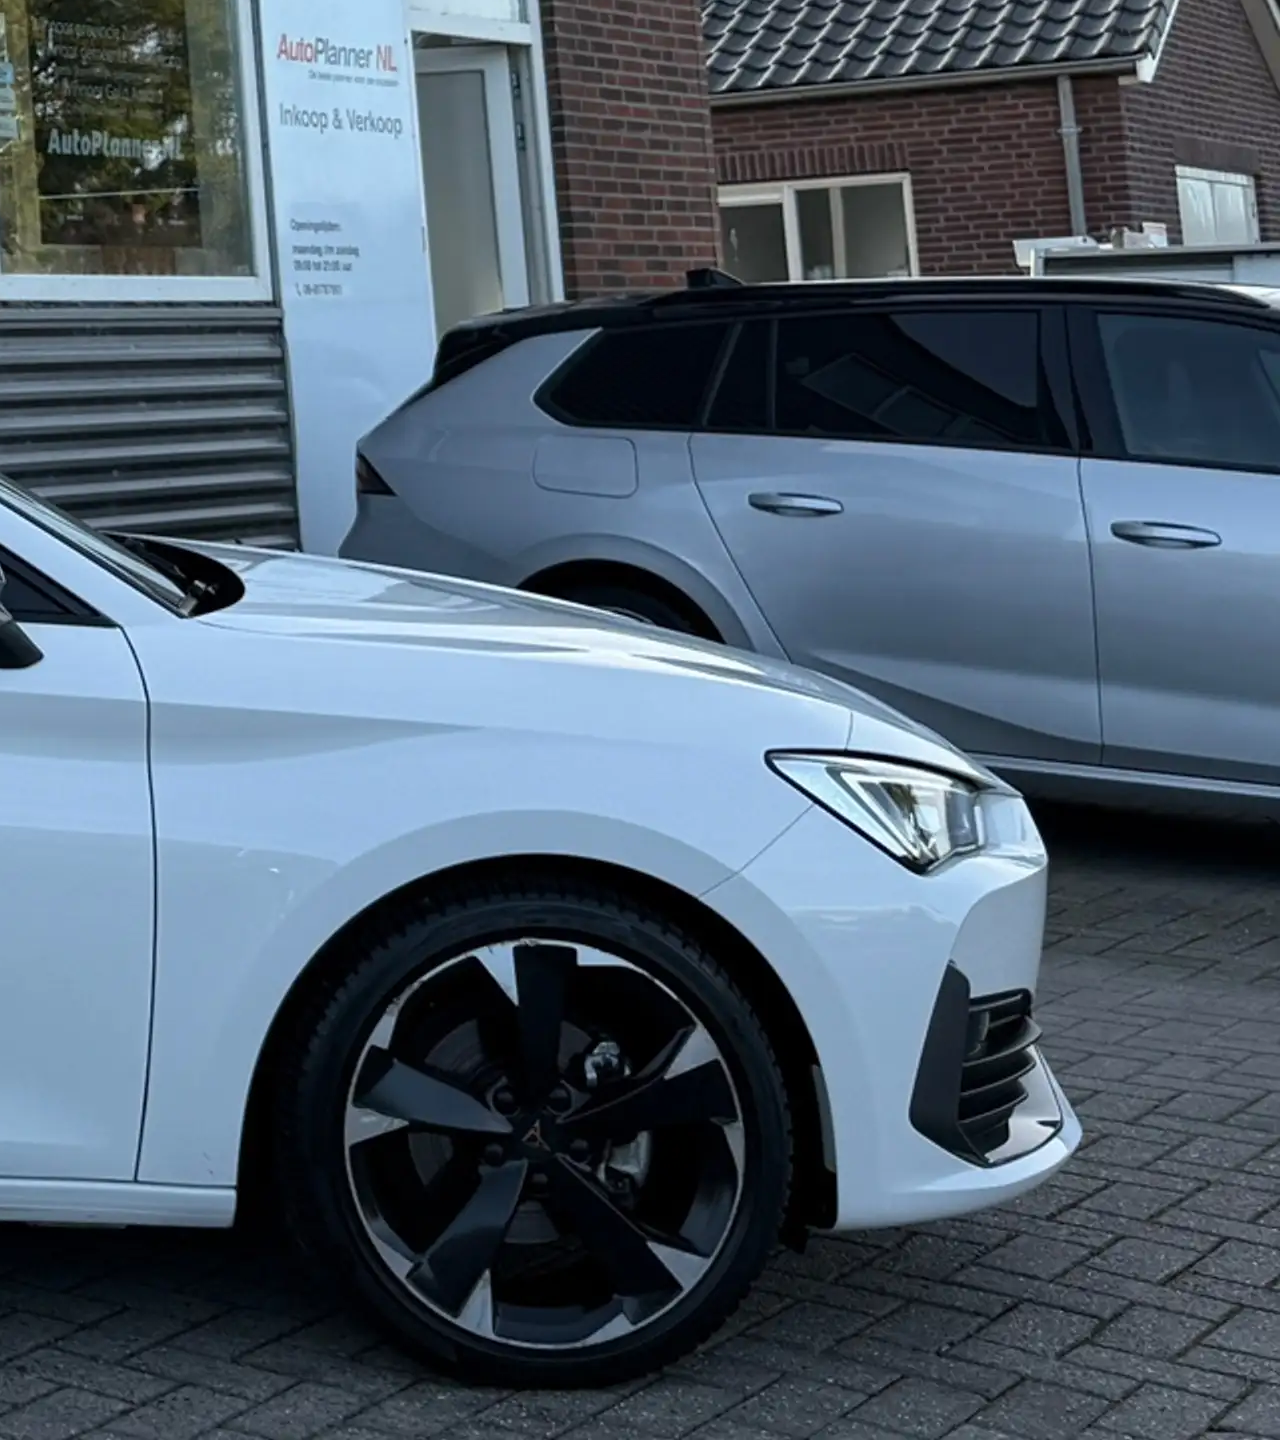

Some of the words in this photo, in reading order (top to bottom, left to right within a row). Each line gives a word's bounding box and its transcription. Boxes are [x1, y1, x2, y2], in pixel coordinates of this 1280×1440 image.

[277, 33, 373, 69] AutoPlanner
[376, 44, 397, 72] NL
[279, 102, 329, 135] Inkoop
[332, 107, 343, 130] &
[346, 108, 403, 139] Verkoop
